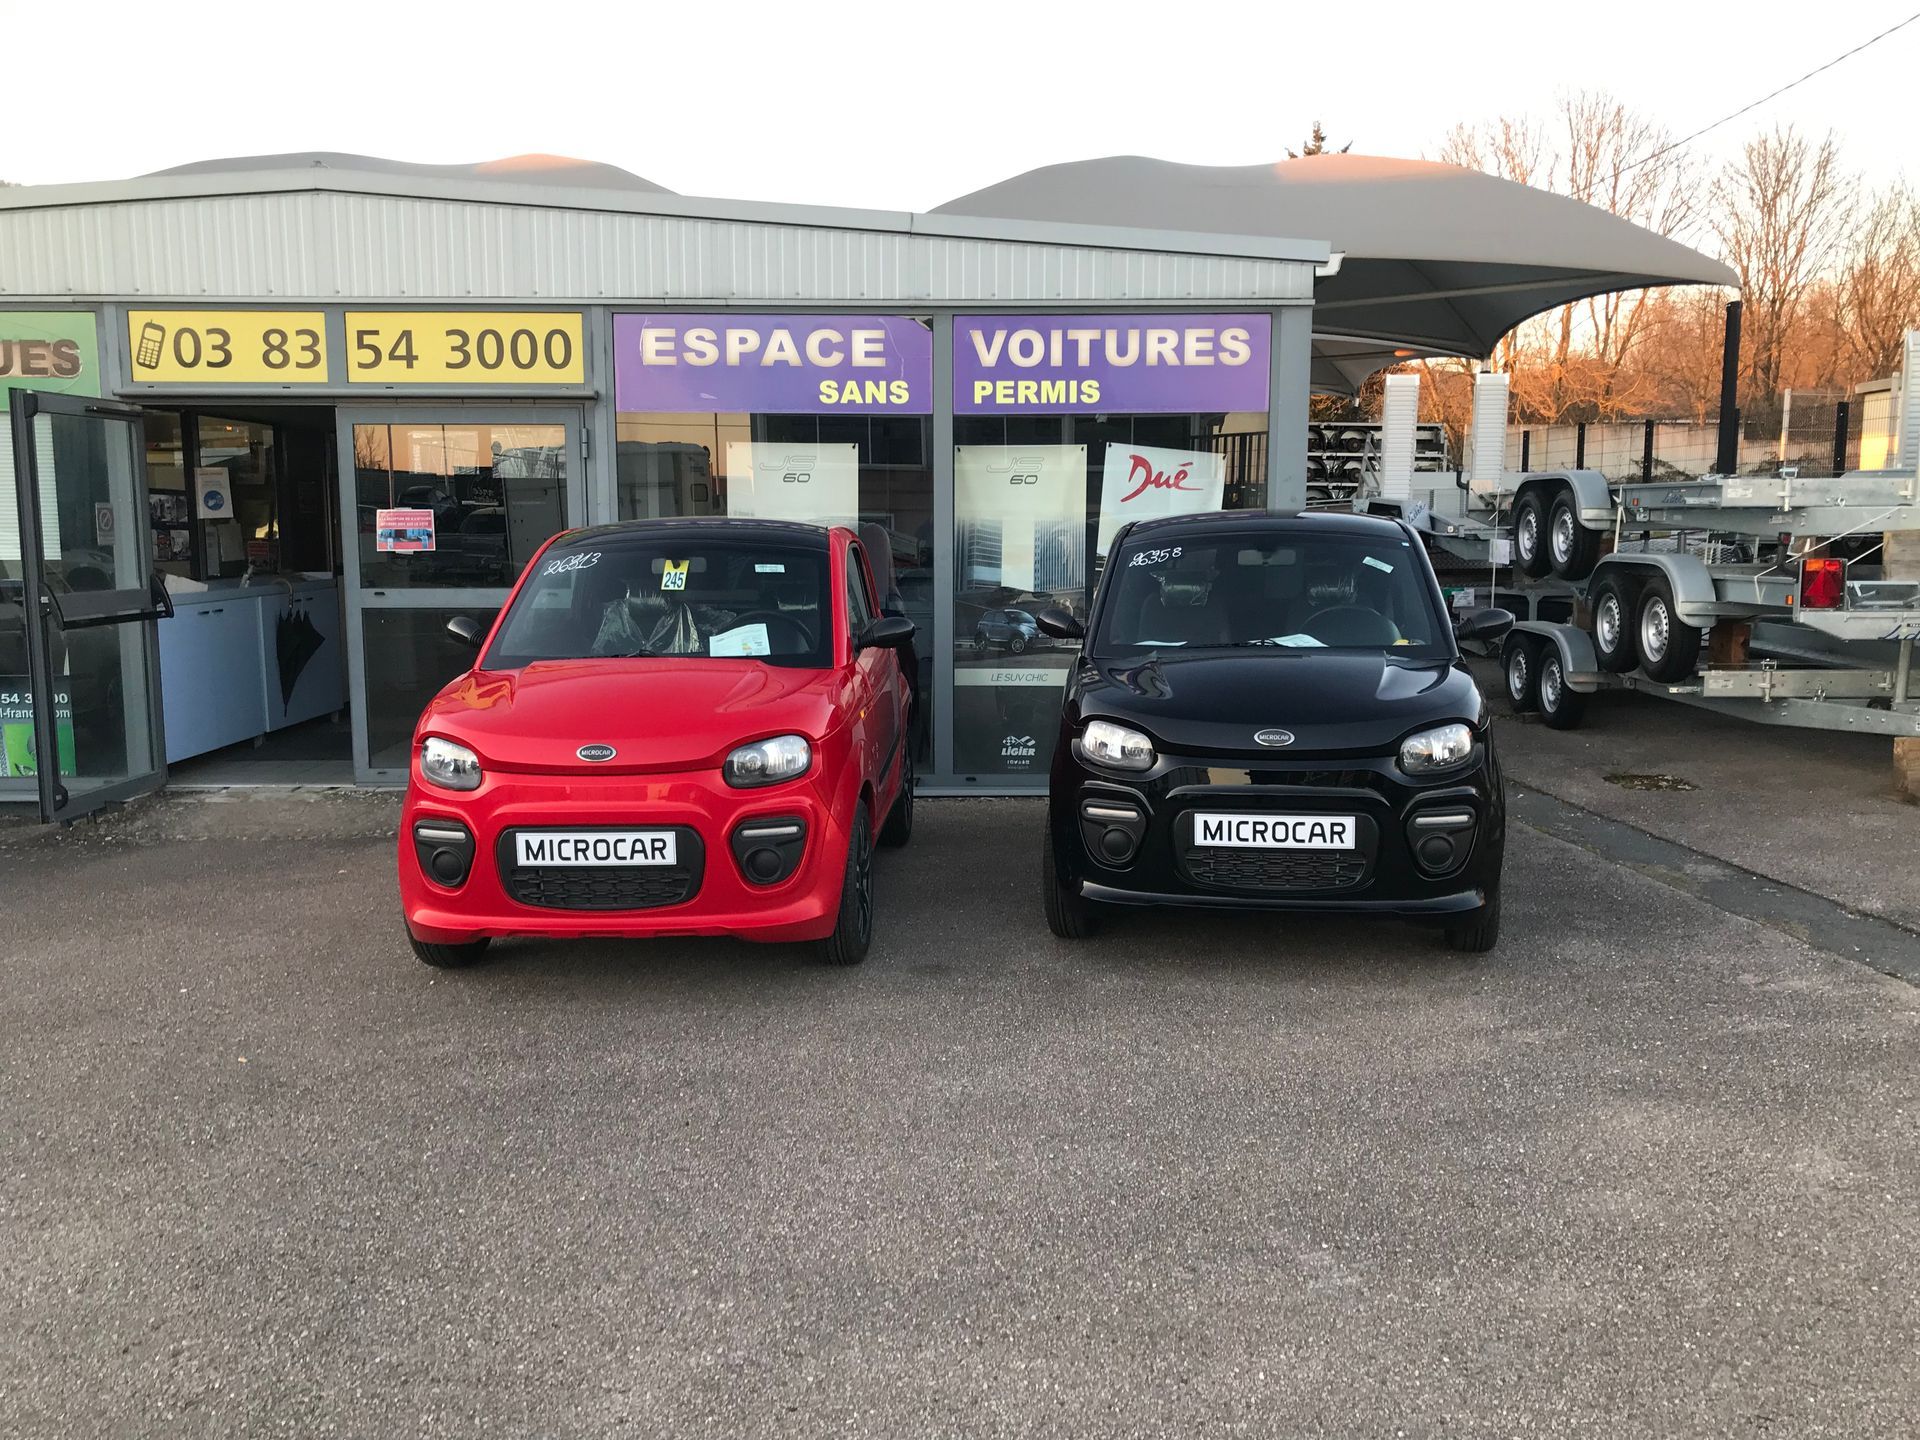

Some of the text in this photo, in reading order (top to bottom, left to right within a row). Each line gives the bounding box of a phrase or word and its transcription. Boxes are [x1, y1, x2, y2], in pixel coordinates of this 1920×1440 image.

[173, 327, 572, 370] 03 83 54 3000
[641, 327, 1252, 368] ESPACE VOITURES
[818, 379, 1101, 405] SANS PERMIS
[759, 455, 817, 471] JS
[986, 456, 1044, 473] JS
[783, 472, 811, 483] 60
[1010, 474, 1038, 484] 60
[1120, 454, 1204, 503] Dué
[663, 571, 684, 588] 245
[990, 673, 1048, 682] LE SUV CHIC
[0, 693, 20, 704] 54
[1203, 820, 1346, 844] MICROCAR
[524, 838, 667, 861] MICROCAR
